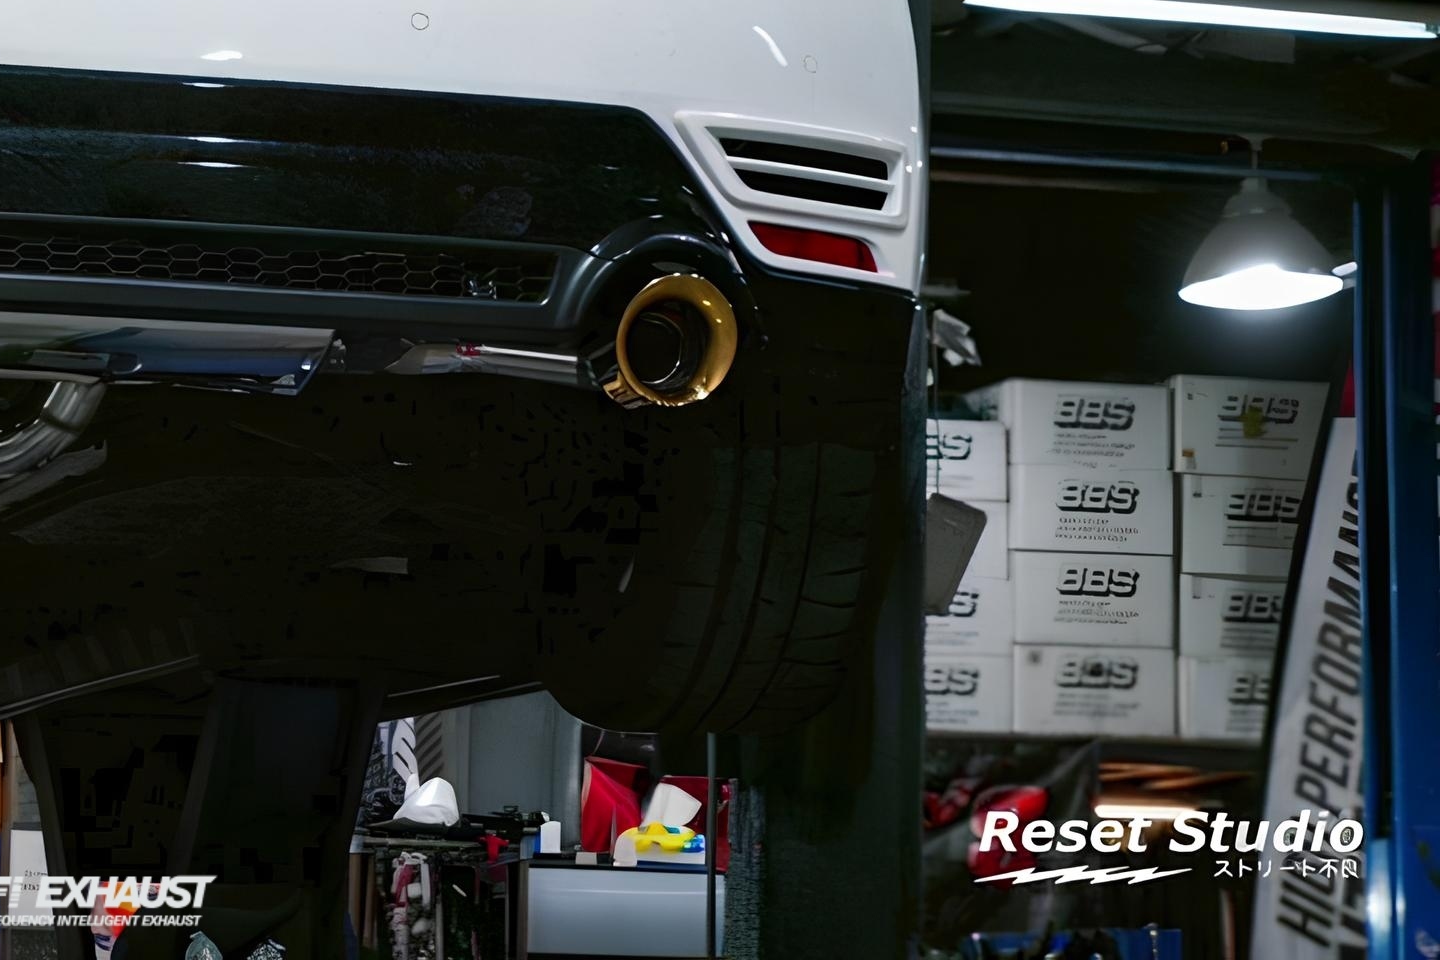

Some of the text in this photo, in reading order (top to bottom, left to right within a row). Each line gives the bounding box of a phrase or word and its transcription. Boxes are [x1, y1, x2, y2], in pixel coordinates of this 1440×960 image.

[1054, 395, 1136, 431] BBS
[926, 433, 973, 460] BS
[1056, 480, 1140, 514] BBS
[1056, 568, 1140, 598] BBS
[925, 666, 979, 696] BS
